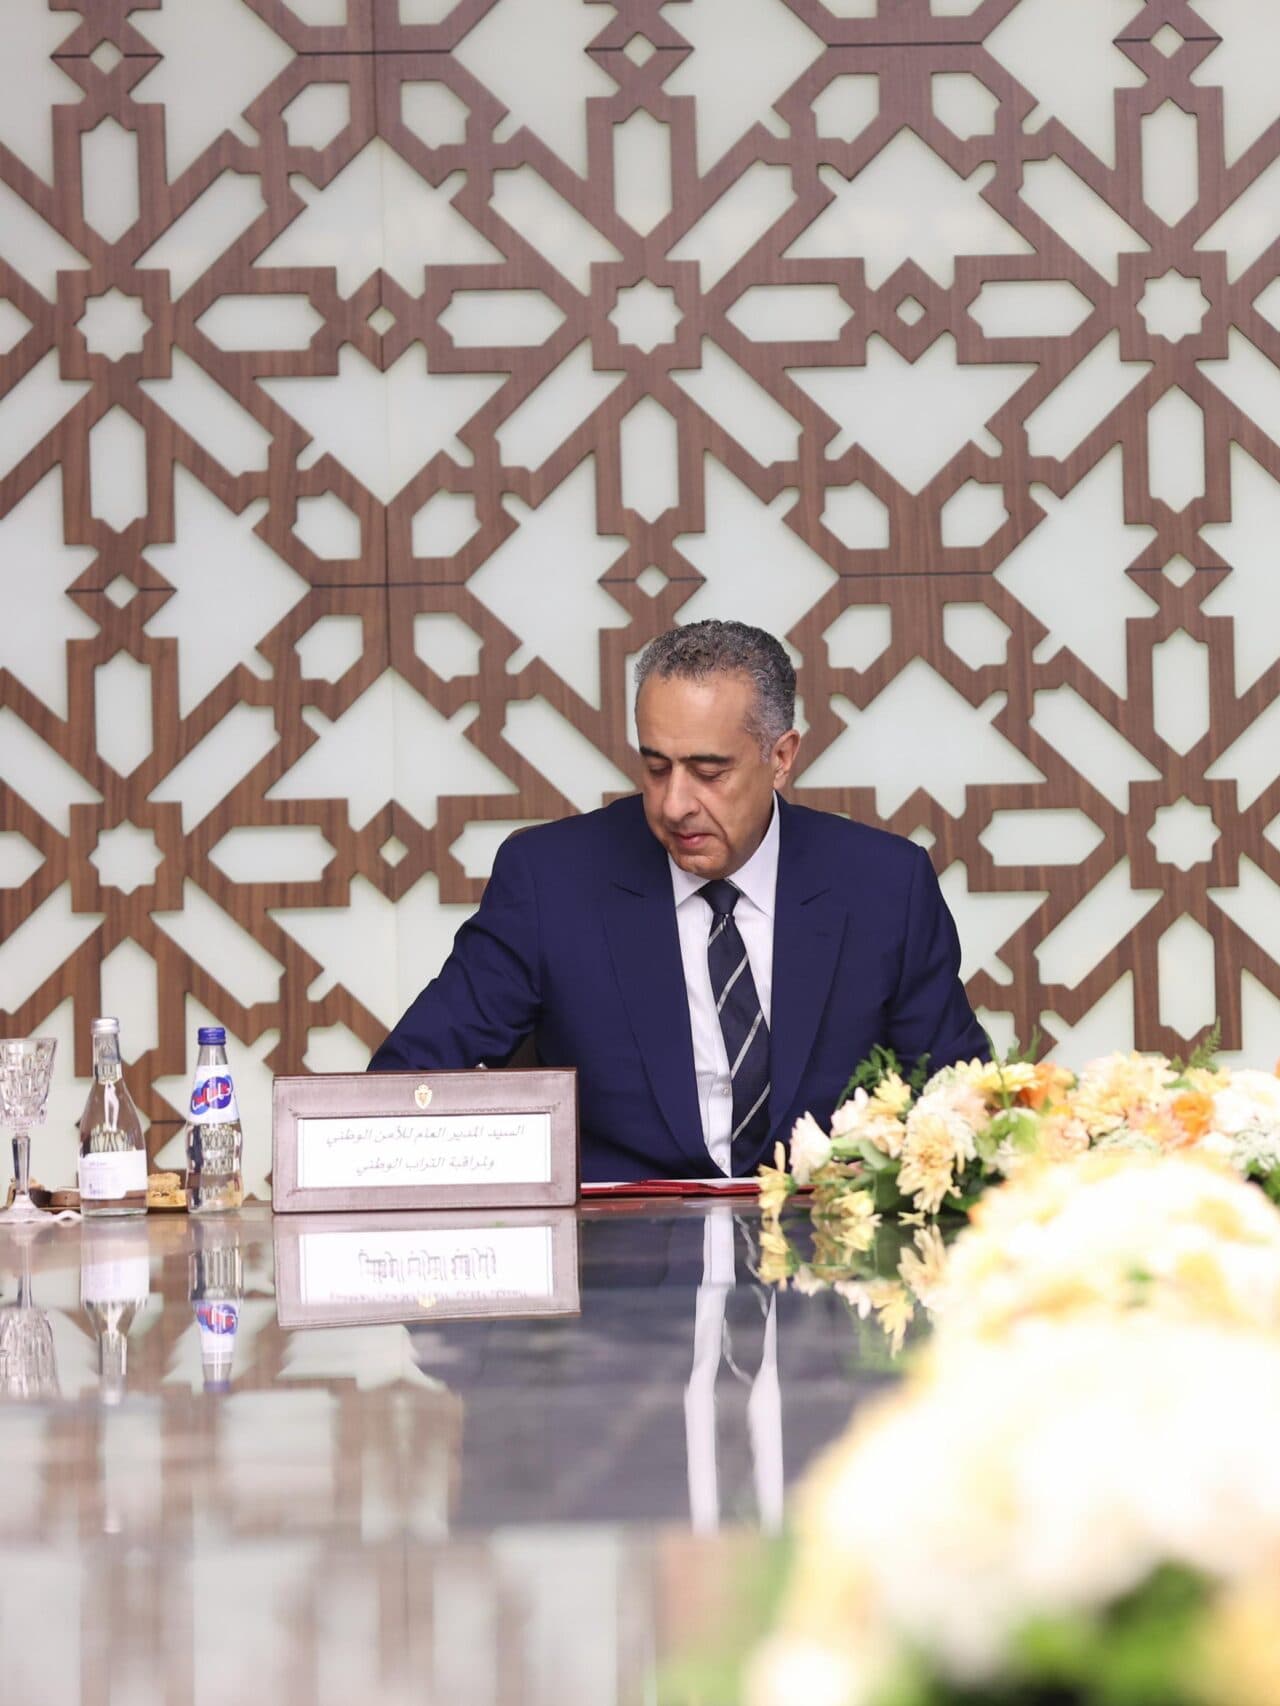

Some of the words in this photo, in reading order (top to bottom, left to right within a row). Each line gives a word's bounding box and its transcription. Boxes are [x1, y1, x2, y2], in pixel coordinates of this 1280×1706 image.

[326, 1127, 373, 1147] الوطني
[375, 1124, 414, 1143] للأمن
[414, 1127, 447, 1146] العام
[447, 1125, 485, 1142] المدير
[487, 1124, 526, 1141] السيد
[356, 1156, 403, 1177] الوطني
[405, 1156, 445, 1172] التراب
